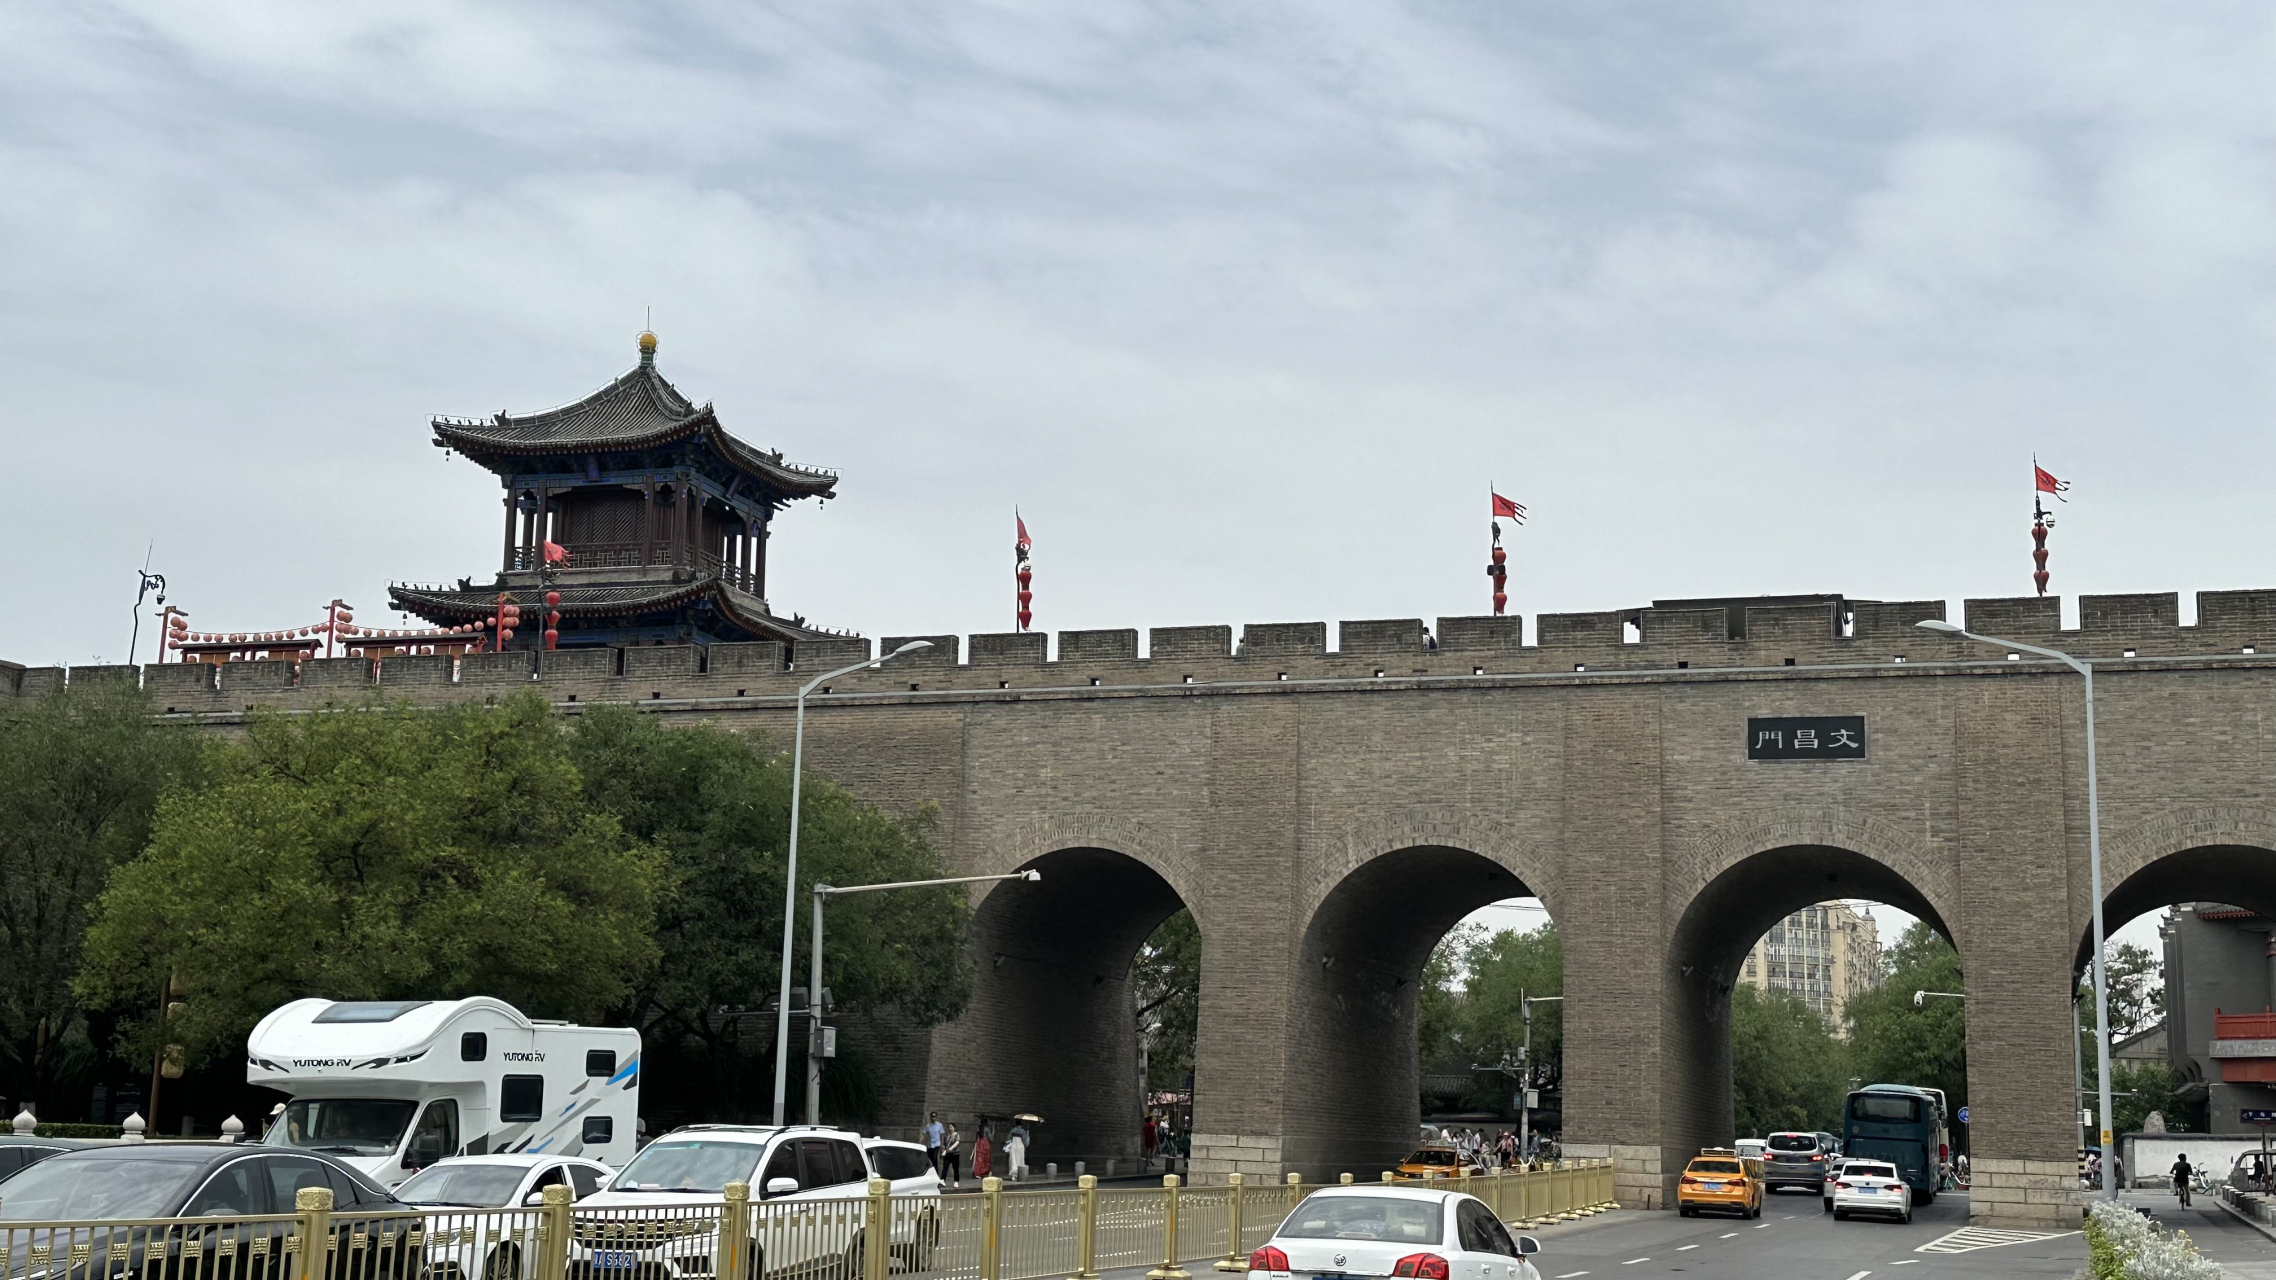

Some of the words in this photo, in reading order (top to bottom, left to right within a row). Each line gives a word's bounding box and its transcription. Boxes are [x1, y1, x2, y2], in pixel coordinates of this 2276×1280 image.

[1755, 728, 1859, 749] 文昌門
[292, 1059, 335, 1068] YUTONG
[336, 1058, 352, 1067] RV
